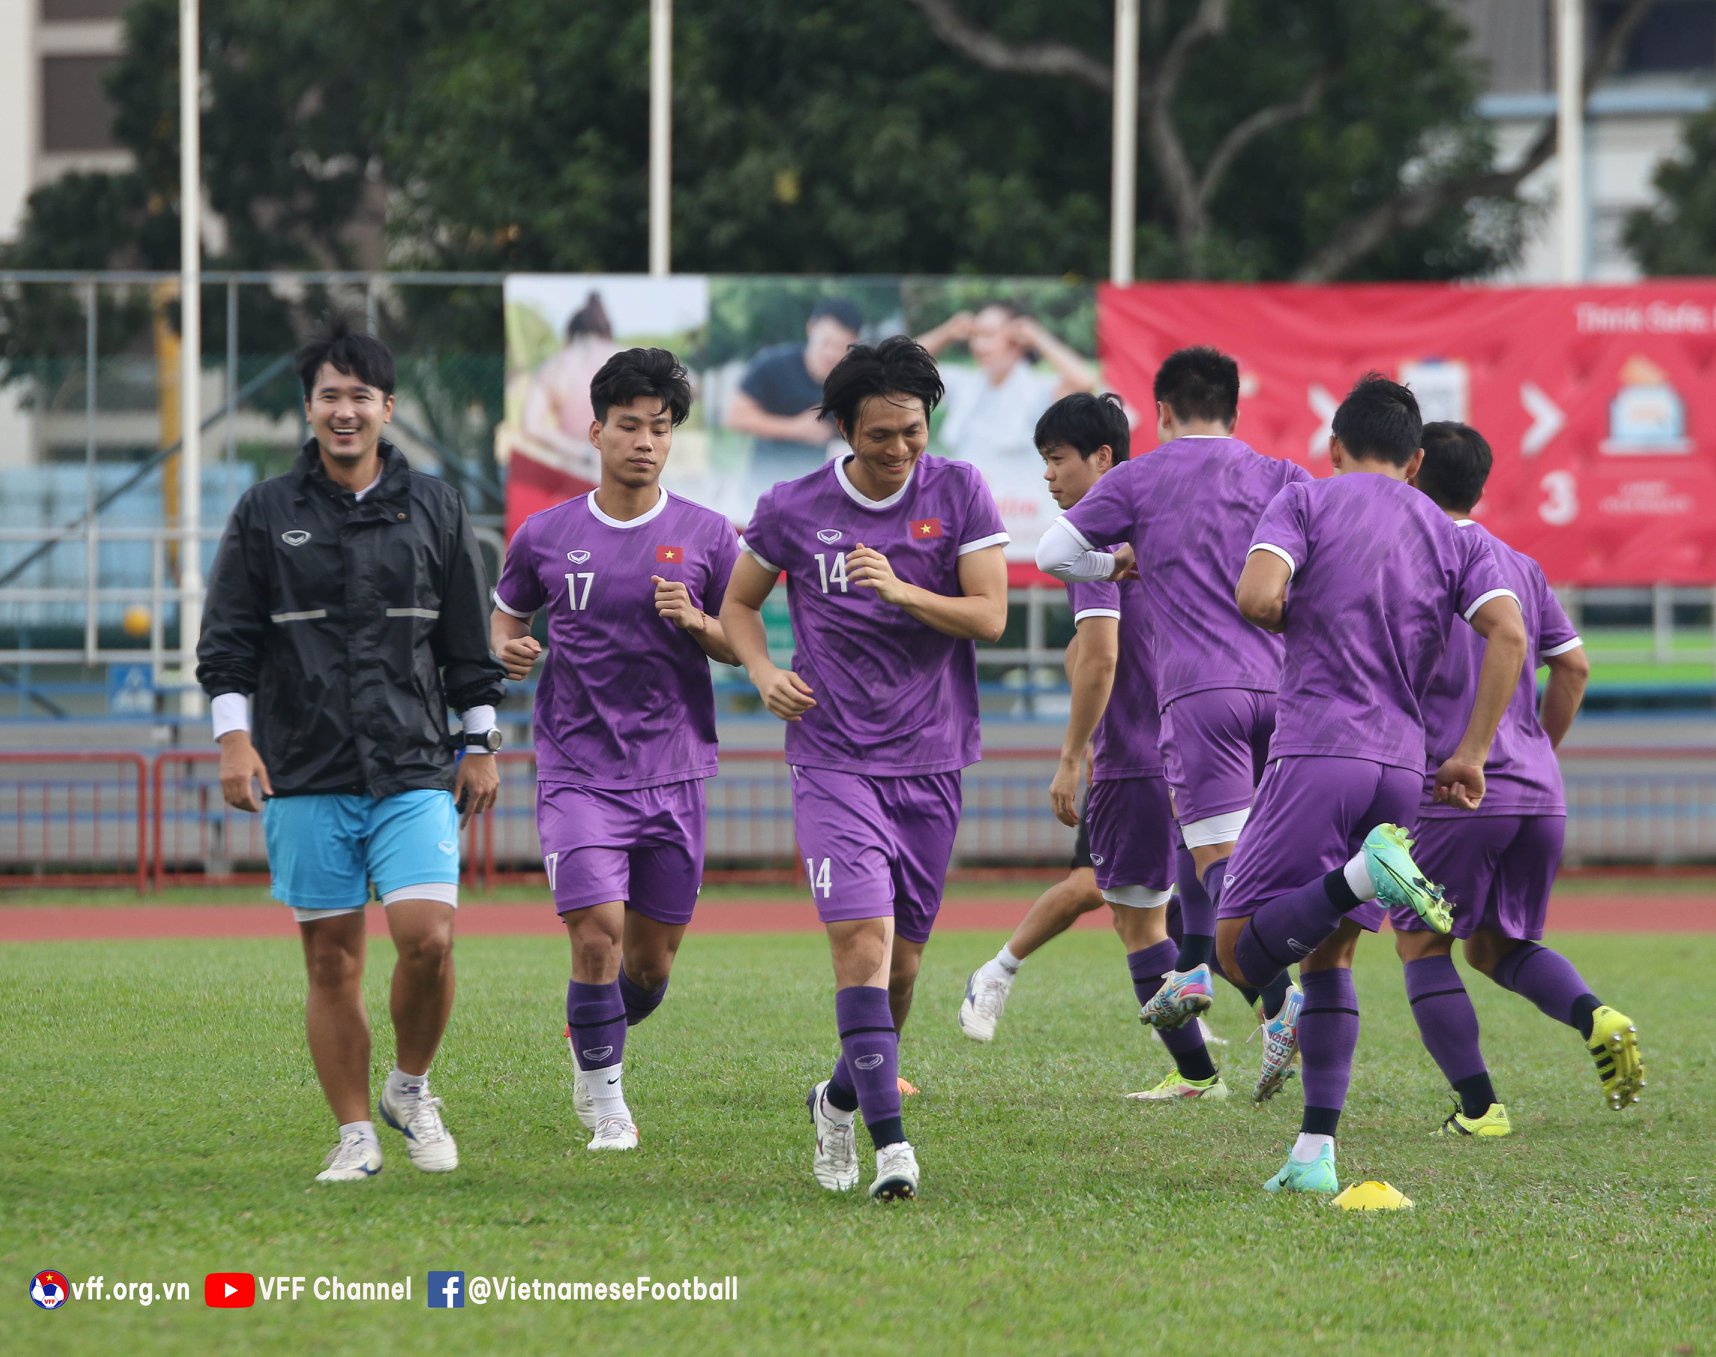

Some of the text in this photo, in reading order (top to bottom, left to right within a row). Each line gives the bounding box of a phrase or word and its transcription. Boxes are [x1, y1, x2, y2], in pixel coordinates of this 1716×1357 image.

[1539, 470, 1579, 526] 3
[564, 572, 595, 611] 17
[813, 552, 848, 594] 14
[806, 857, 833, 899] 14
